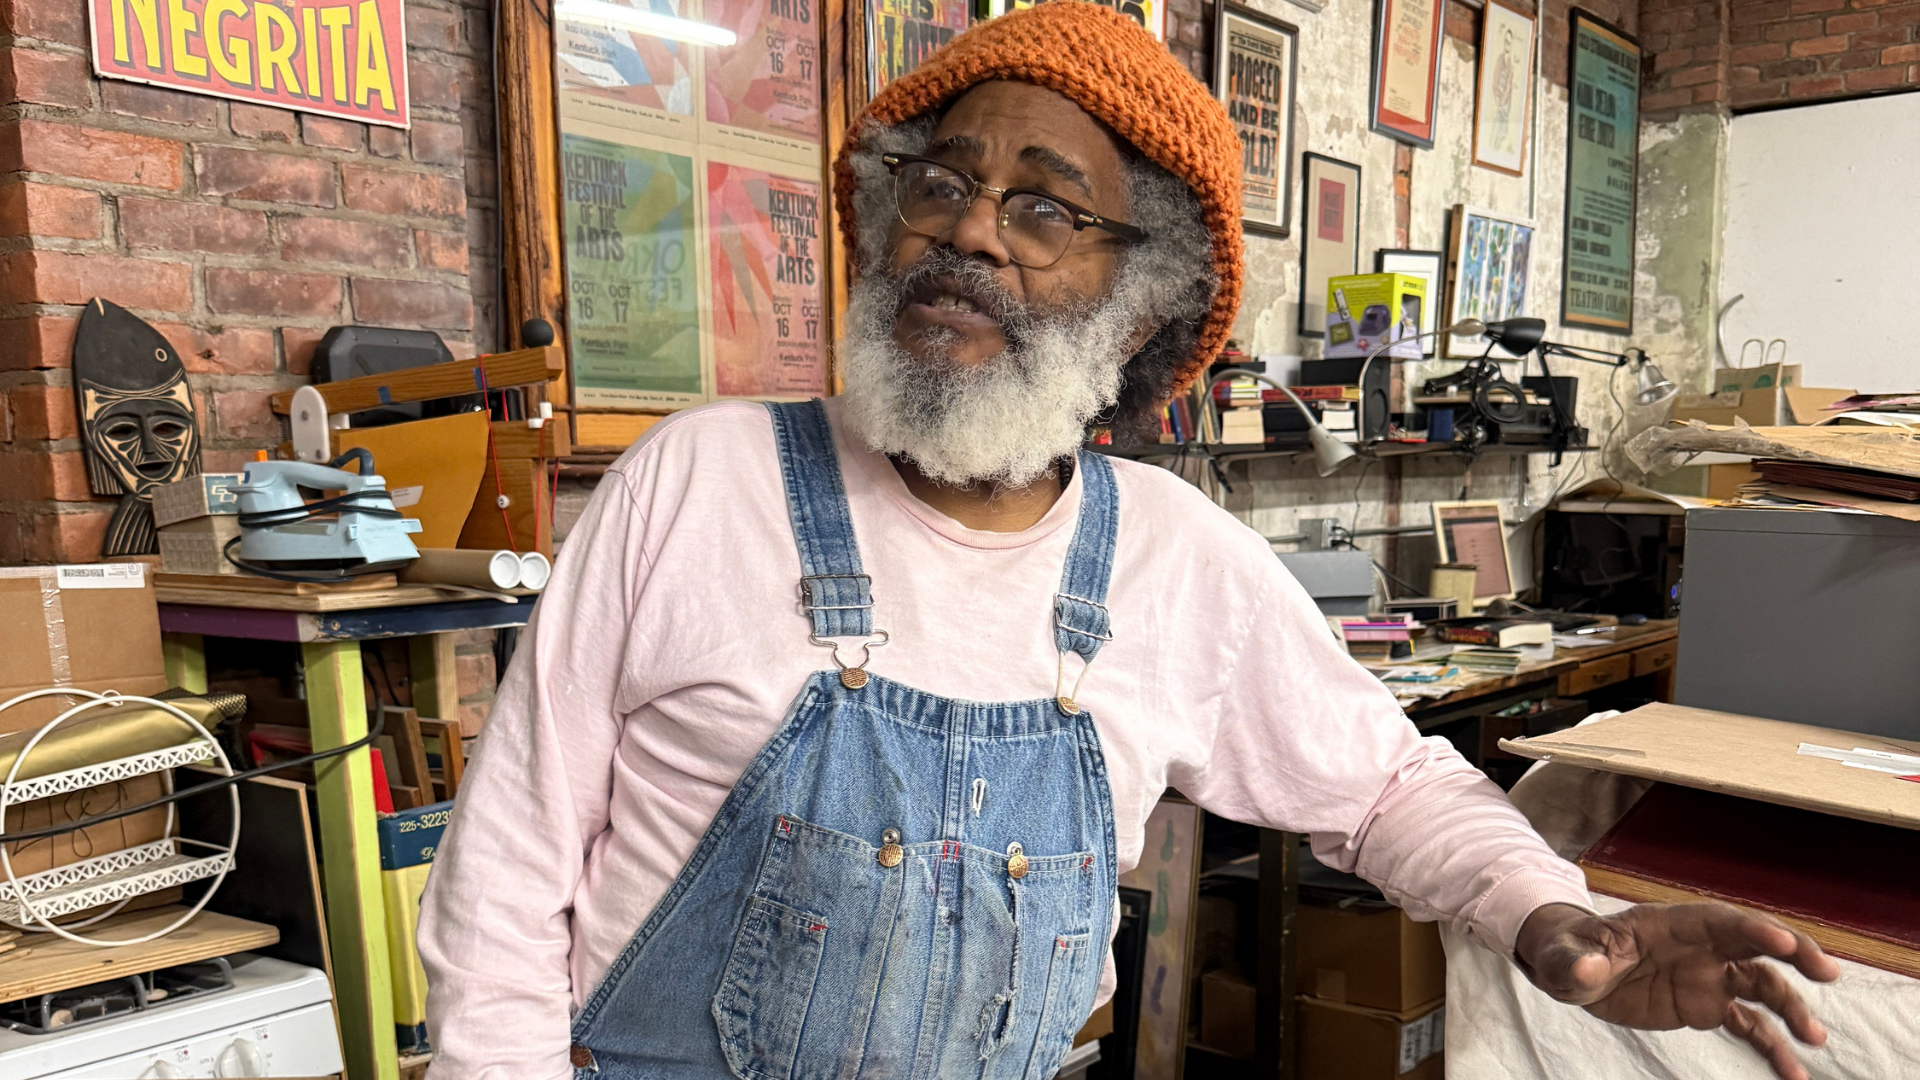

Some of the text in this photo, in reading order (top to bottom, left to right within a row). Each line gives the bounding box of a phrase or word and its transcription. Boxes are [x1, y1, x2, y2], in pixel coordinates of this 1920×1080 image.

[568, 40, 599, 55] Kentuck
[766, 35, 785, 51] OCT
[796, 43, 815, 59] OCT
[112, 0, 396, 111] NEGRITA
[769, 51, 784, 74] 16
[799, 60, 813, 81] 17
[1229, 51, 1282, 106] PROCEED
[1229, 100, 1279, 132] AND BE
[1241, 130, 1277, 178] OLD!
[564, 151, 628, 188] KENTUCK
[567, 179, 628, 210] FESTIVAL
[769, 189, 818, 220] KENTUCK
[580, 204, 617, 230] OF THE
[771, 214, 818, 239] FESTIVAL
[576, 225, 625, 262] ARTS
[794, 236, 809, 257] THE
[776, 253, 815, 286] ARTS
[571, 280, 596, 296] OCT
[609, 284, 631, 299] OCT
[1570, 288, 1604, 311] TEATRO
[576, 297, 594, 321] 16
[613, 300, 629, 324] 17
[773, 303, 791, 316] OCT
[802, 305, 821, 319] OCT
[776, 318, 789, 338] 16
[805, 320, 818, 340] 17
[400, 810, 453, 833] 225-3223
